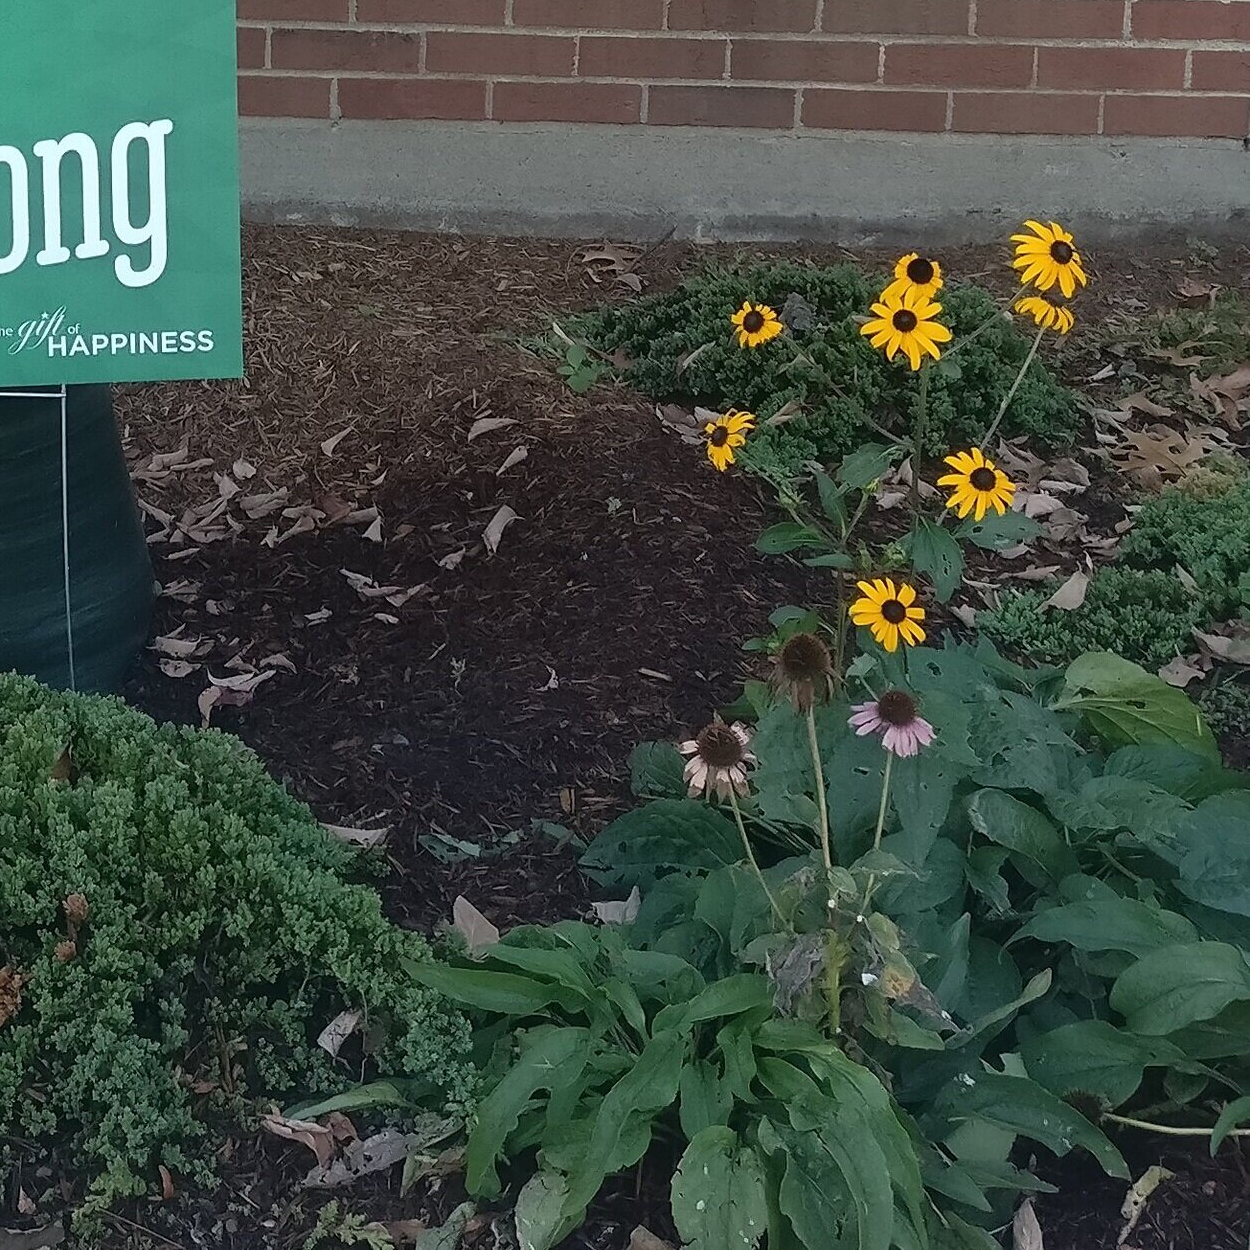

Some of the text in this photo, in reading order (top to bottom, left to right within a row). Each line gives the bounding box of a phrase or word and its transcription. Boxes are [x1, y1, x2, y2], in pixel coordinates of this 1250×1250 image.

[7, 305, 67, 356] gift
[67, 323, 82, 336] of
[47, 330, 215, 358] HAPPINESS
